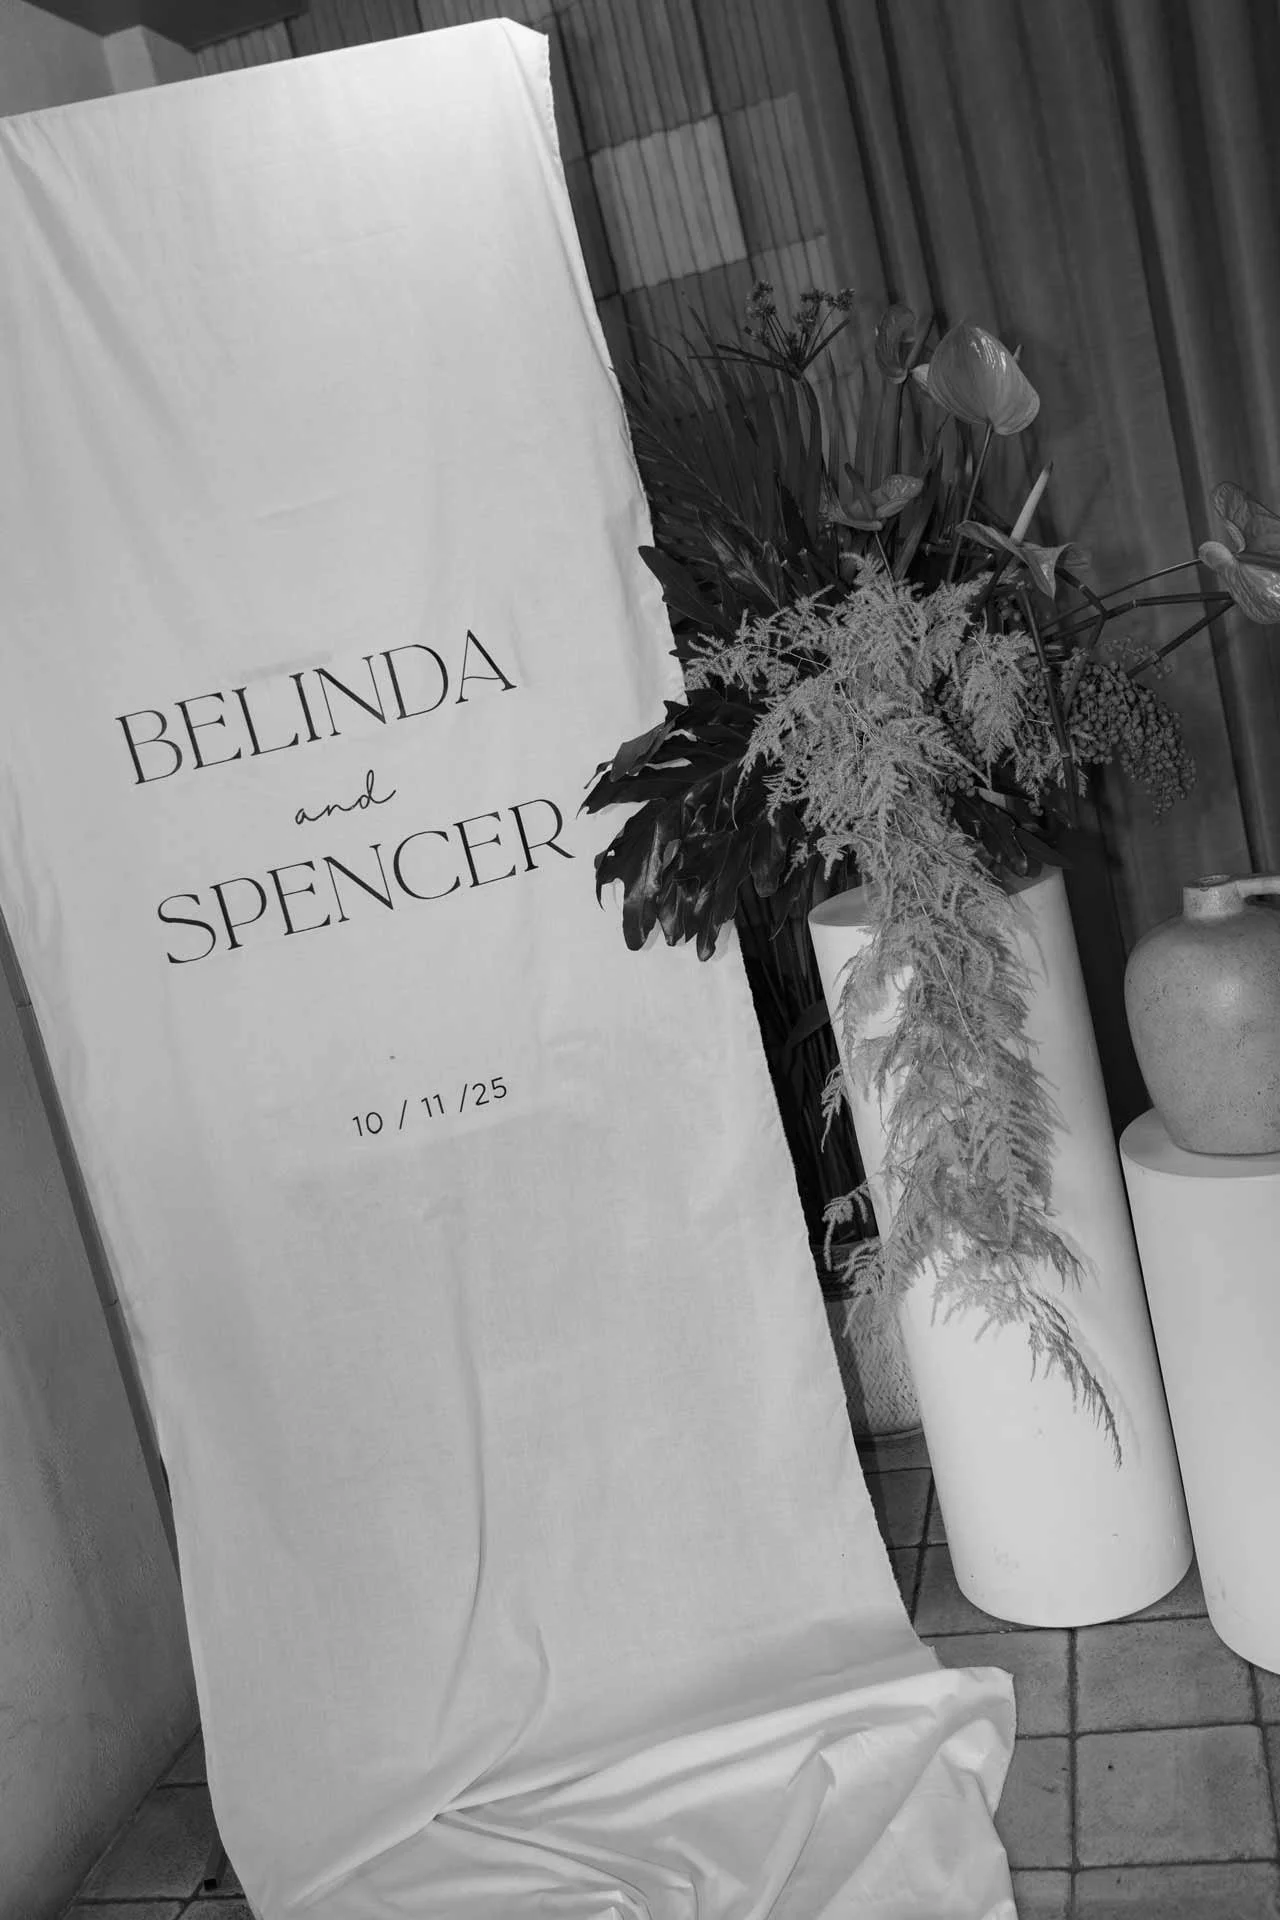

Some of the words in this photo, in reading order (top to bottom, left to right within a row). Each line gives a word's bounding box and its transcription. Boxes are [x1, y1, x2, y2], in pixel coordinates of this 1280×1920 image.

[114, 629, 518, 784] BELINDA
[294, 769, 397, 825] and
[156, 798, 575, 964] SPENCER
